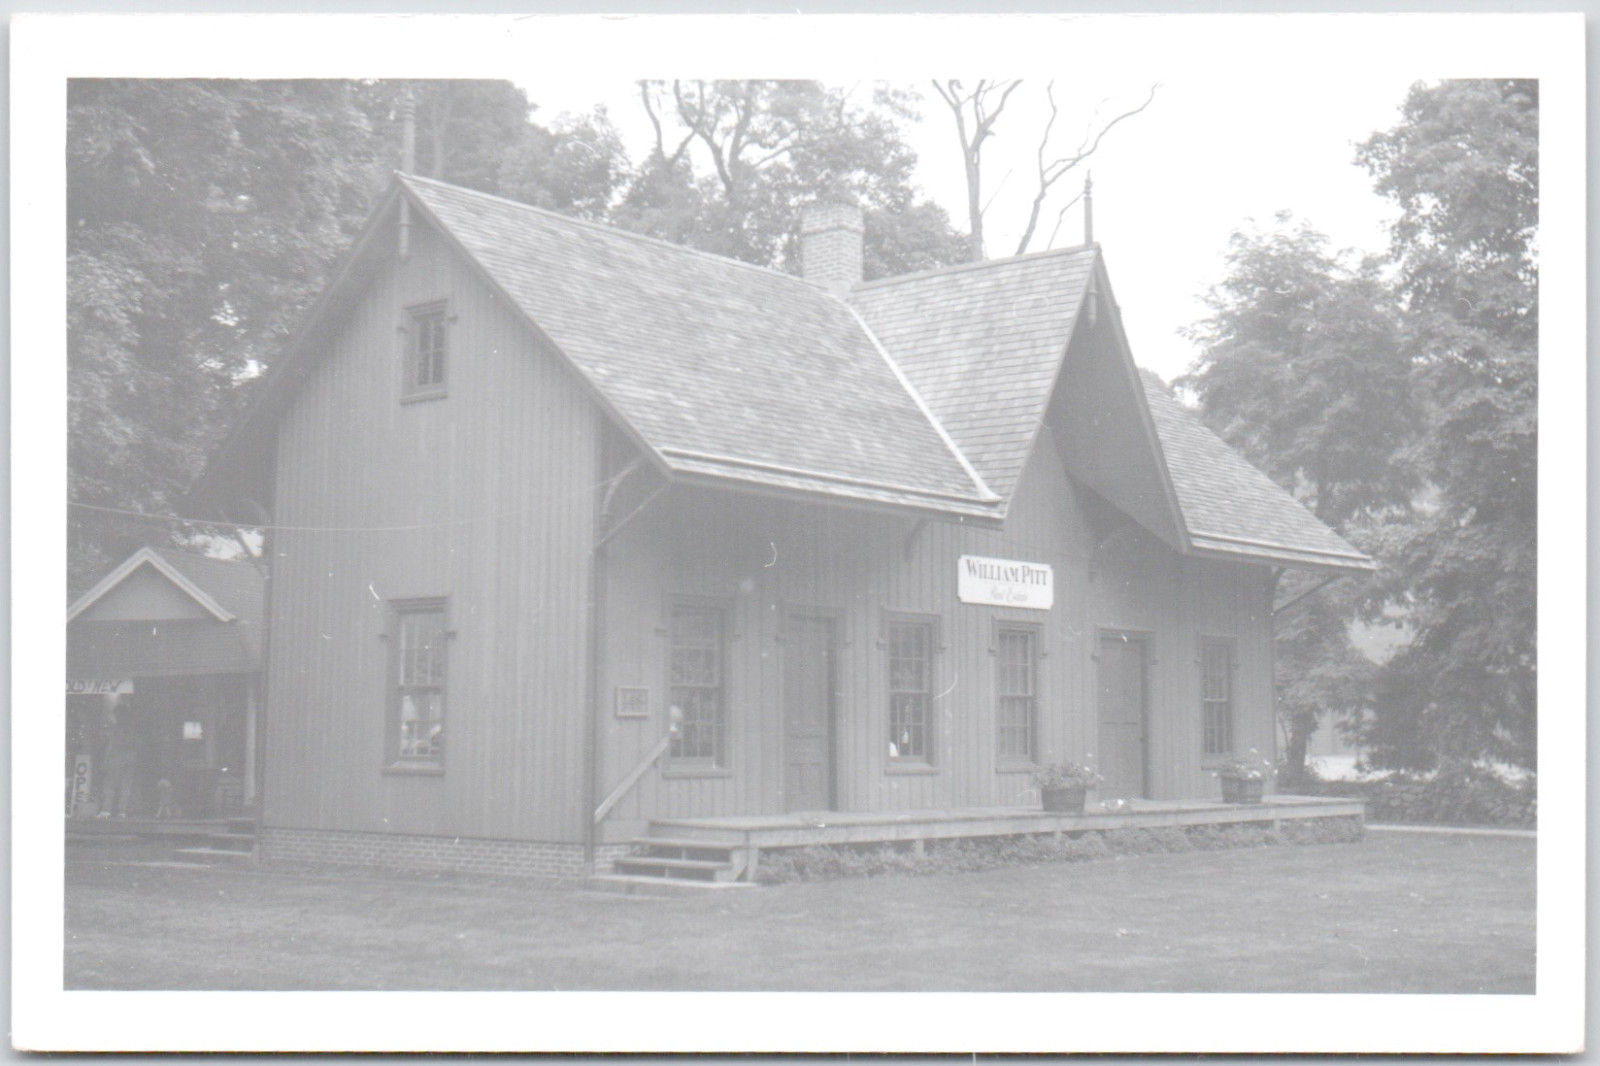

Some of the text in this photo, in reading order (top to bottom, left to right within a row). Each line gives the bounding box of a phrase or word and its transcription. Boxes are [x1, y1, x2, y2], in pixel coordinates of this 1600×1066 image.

[965, 559, 1019, 582] WILLIAM
[1021, 565, 1047, 586] PITT
[74, 762, 88, 806] OPE
